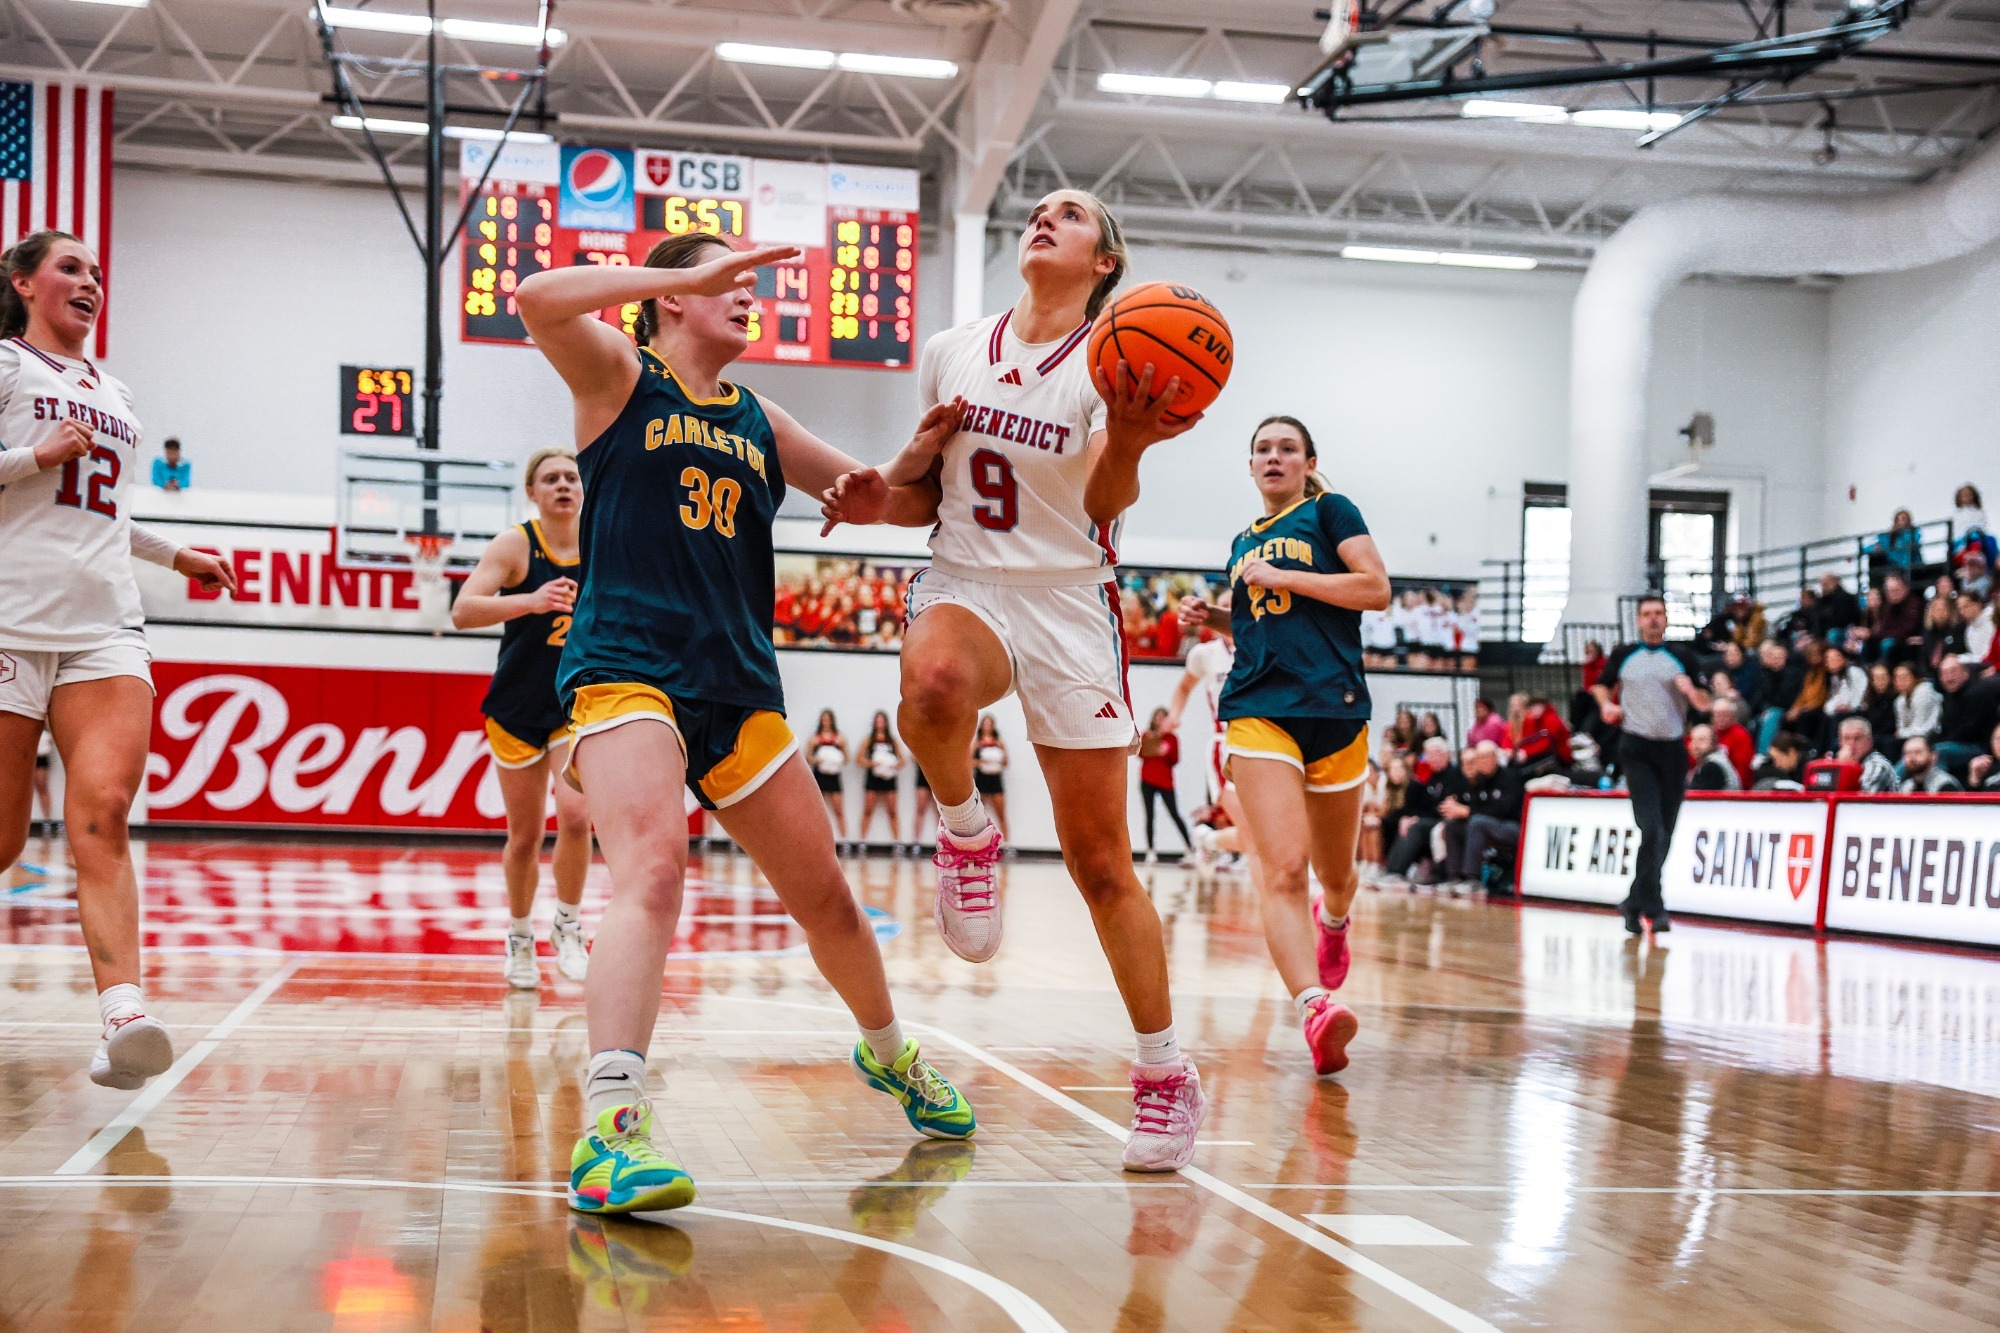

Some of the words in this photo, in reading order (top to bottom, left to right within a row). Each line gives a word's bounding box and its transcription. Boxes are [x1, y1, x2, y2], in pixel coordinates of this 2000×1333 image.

[678, 160, 740, 191] CSB
[665, 196, 743, 236] 6:57
[507, 222, 517, 243] 1
[870, 224, 880, 244] 1
[507, 247, 517, 267] 1
[776, 267, 808, 300] 14
[829, 267, 859, 290] 21
[869, 272, 879, 291] 1
[895, 273, 911, 294] 4
[894, 295, 911, 319] 5
[797, 317, 806, 342] 1
[868, 319, 878, 339] 1
[894, 319, 911, 343] 5
[358, 369, 411, 395] 6:57
[353, 393, 402, 432] 27
[961, 404, 1071, 456] BENEDICT
[55, 443, 122, 521] 12
[969, 447, 1020, 534] 9
[679, 466, 742, 539] 30
[148, 673, 508, 819] Benn
[1546, 826, 1577, 871] WE
[1588, 828, 1633, 876] ARE
[1693, 830, 1781, 890] SAINT
